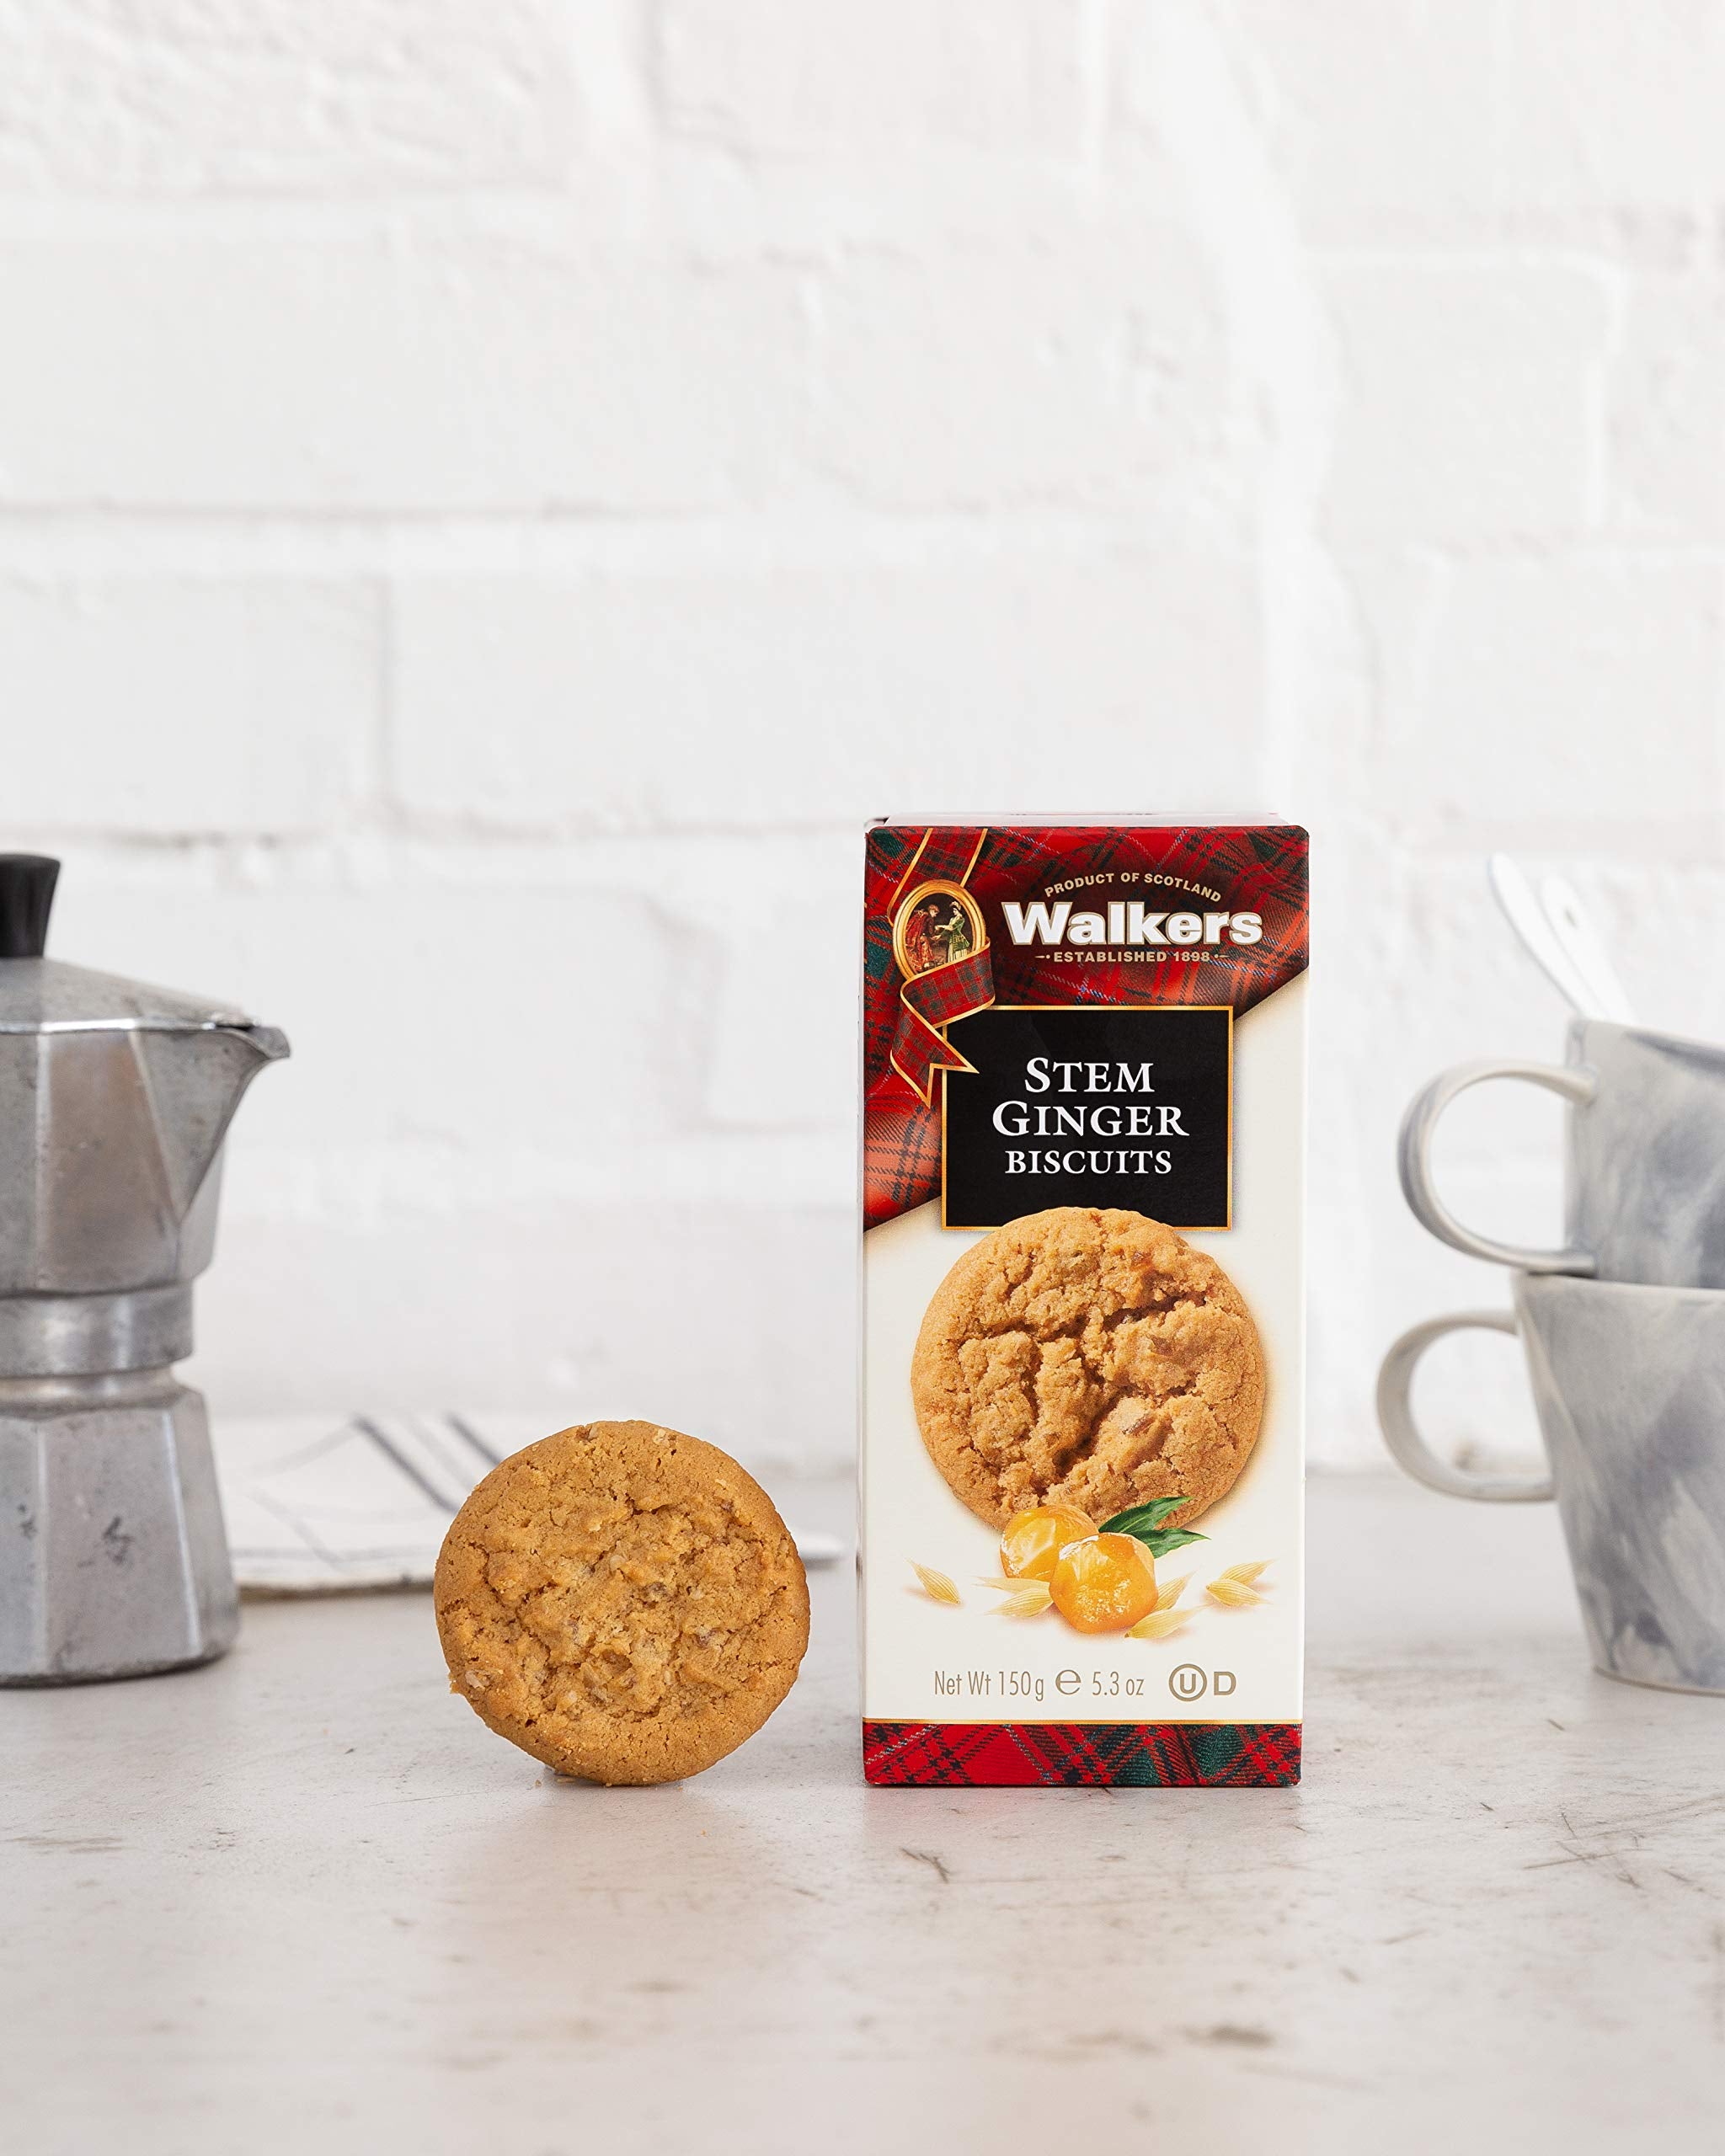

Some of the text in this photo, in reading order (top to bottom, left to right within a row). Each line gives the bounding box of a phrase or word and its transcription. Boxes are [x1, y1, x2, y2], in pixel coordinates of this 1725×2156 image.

[1044, 872, 1221, 902] PRODUCT OF SCOTLAND
[1002, 902, 1263, 946] Walkers
[1054, 951, 1210, 963] ESTABLISHED 1898
[1024, 1057, 1155, 1093] STEM
[992, 1101, 1189, 1138] GINGER
[1005, 1150, 1172, 1175] BISCUITS
[934, 1670, 962, 1696] Net
[967, 1670, 991, 1696] Wt
[1092, 1670, 1121, 1696] 5.3
[1125, 1677, 1145, 1696] oz
[1214, 1671, 1237, 1696] D
